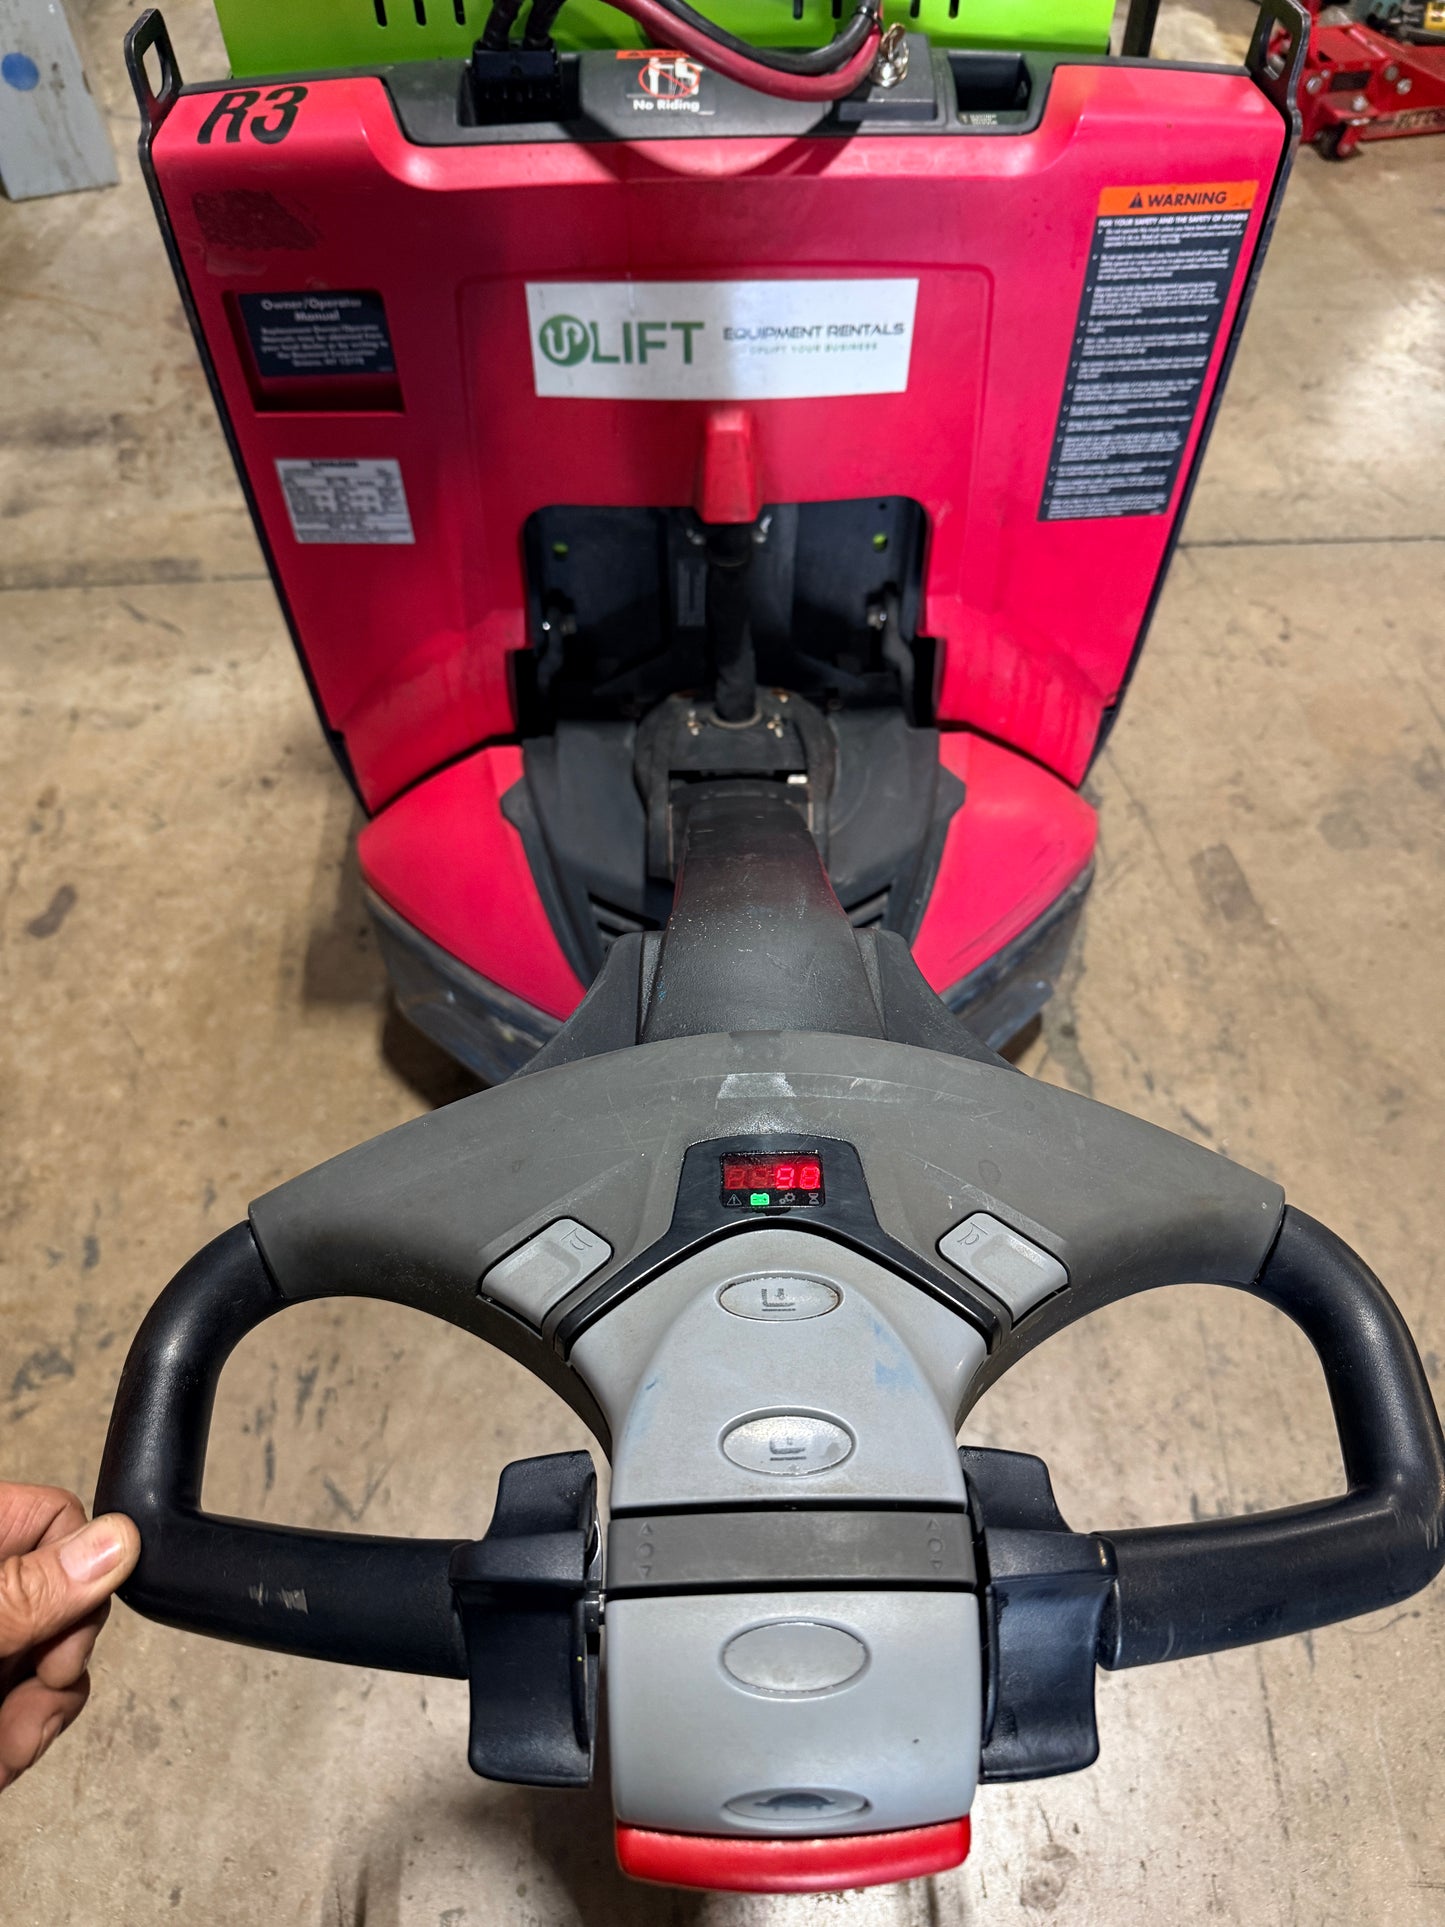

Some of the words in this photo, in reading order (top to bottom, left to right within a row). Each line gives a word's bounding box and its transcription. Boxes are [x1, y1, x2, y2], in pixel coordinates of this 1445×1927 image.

[633, 100, 654, 111] No
[657, 99, 700, 112] Riding
[197, 86, 308, 144] R3
[1148, 191, 1227, 207] WARNING
[261, 297, 362, 311] Owner/Operator
[294, 309, 341, 322] Manual
[723, 326, 822, 341] EQUIPMENT
[827, 322, 905, 337] RENTALS
